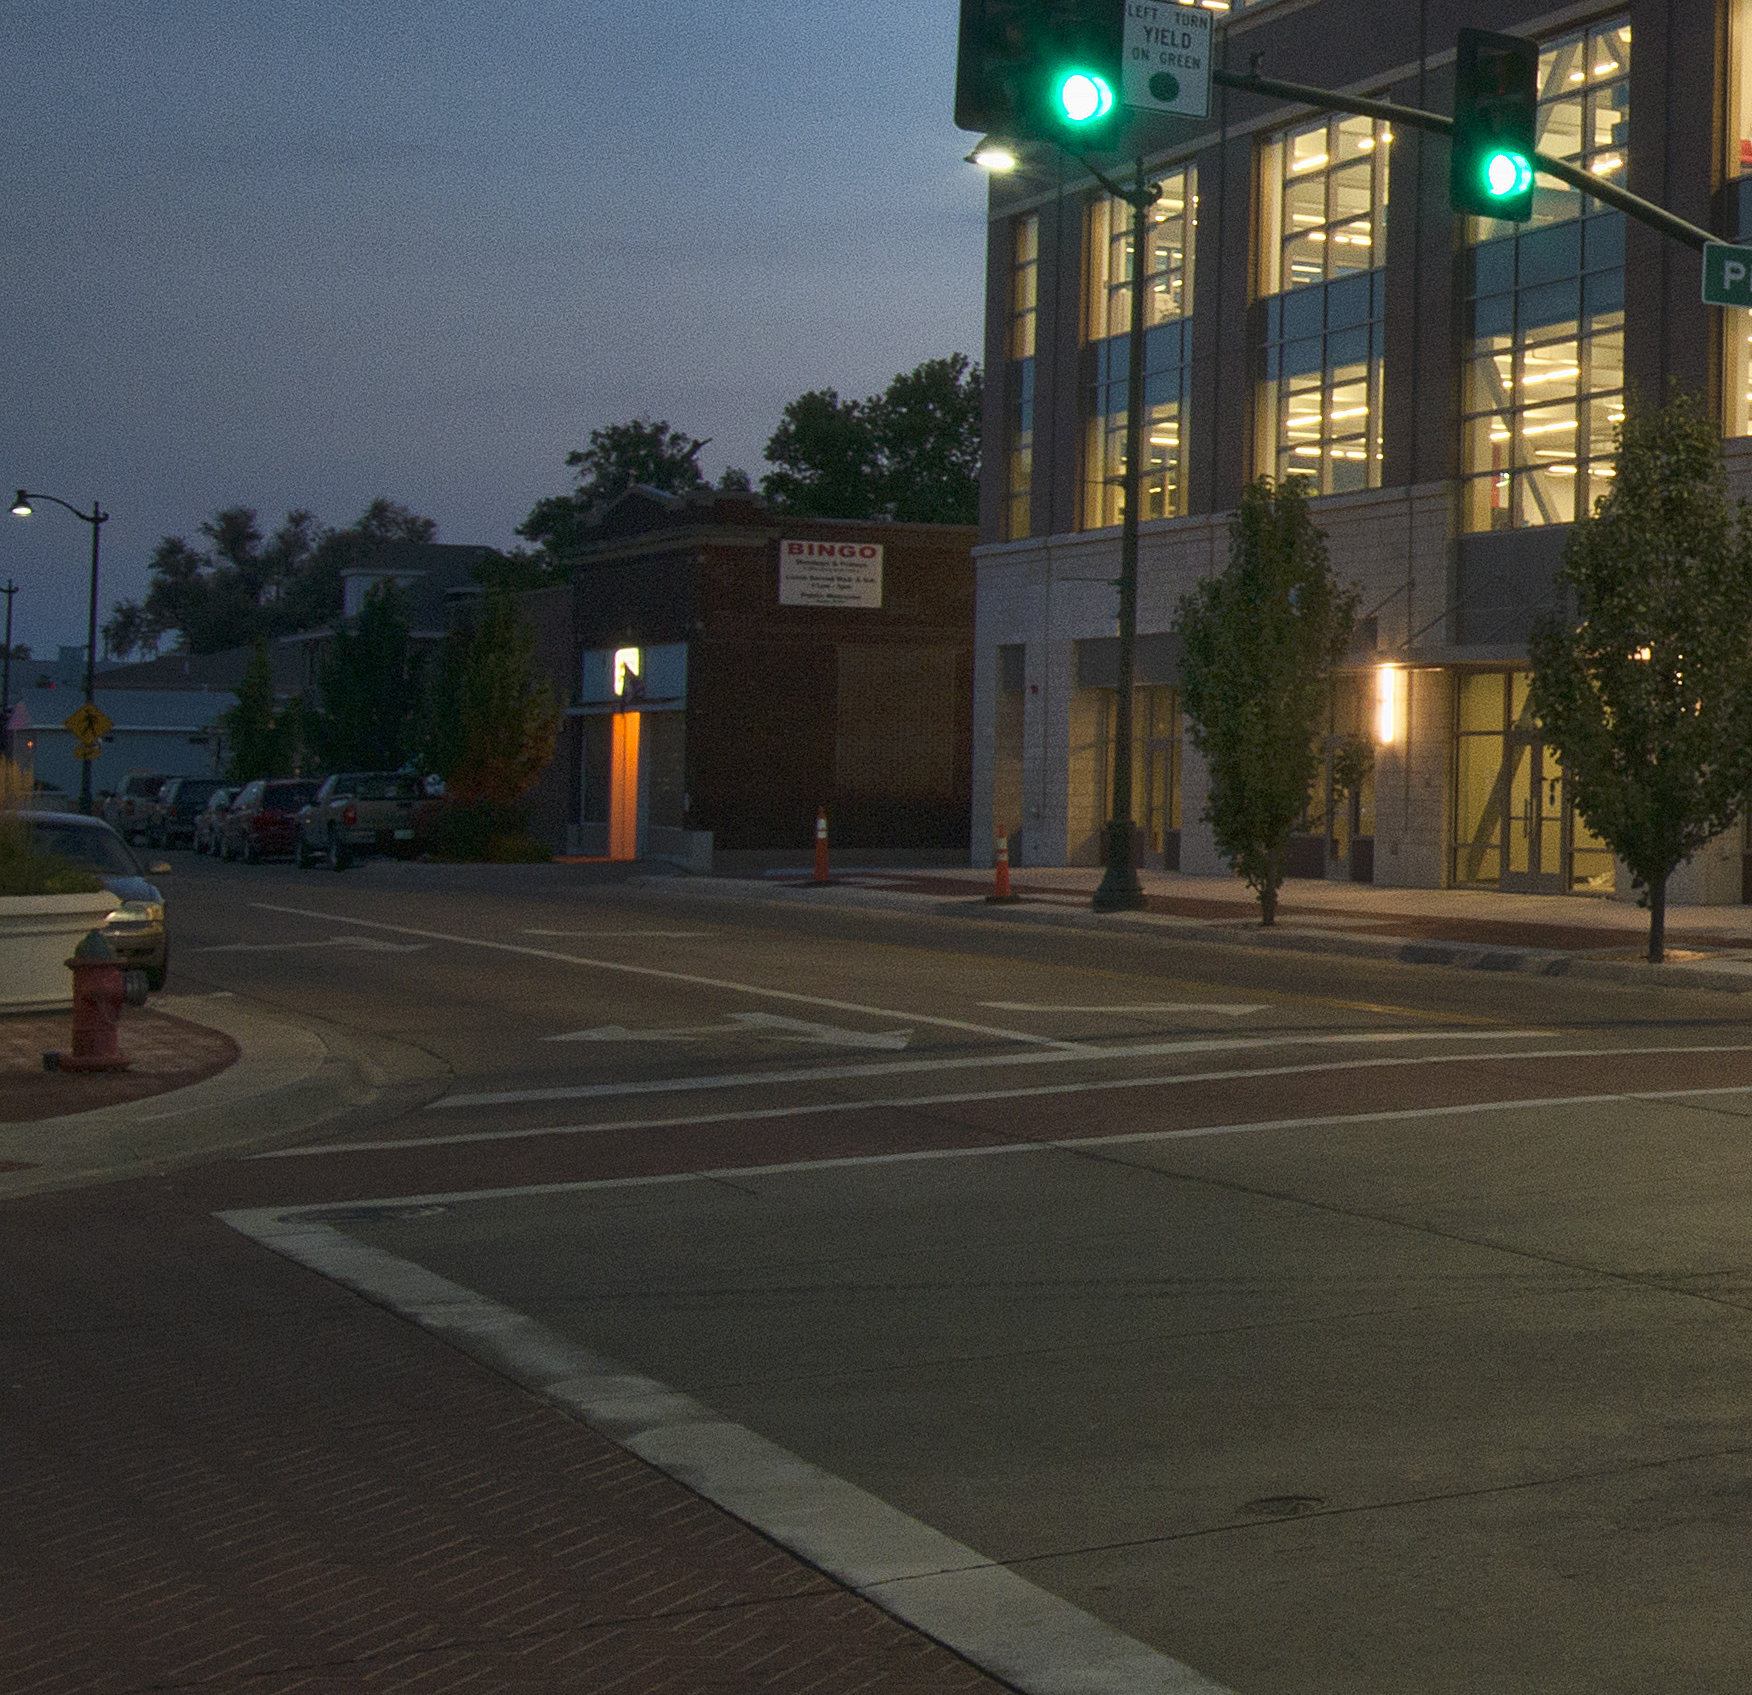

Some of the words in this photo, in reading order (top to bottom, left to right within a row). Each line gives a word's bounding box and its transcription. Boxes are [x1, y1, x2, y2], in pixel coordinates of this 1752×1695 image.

[1127, 5, 1159, 20] LEFT
[1175, 11, 1208, 28] TURN
[1144, 25, 1192, 49] YIELD
[1131, 47, 1150, 61] ON
[1159, 51, 1201, 70] GREEN
[787, 542, 876, 558] BINGO
